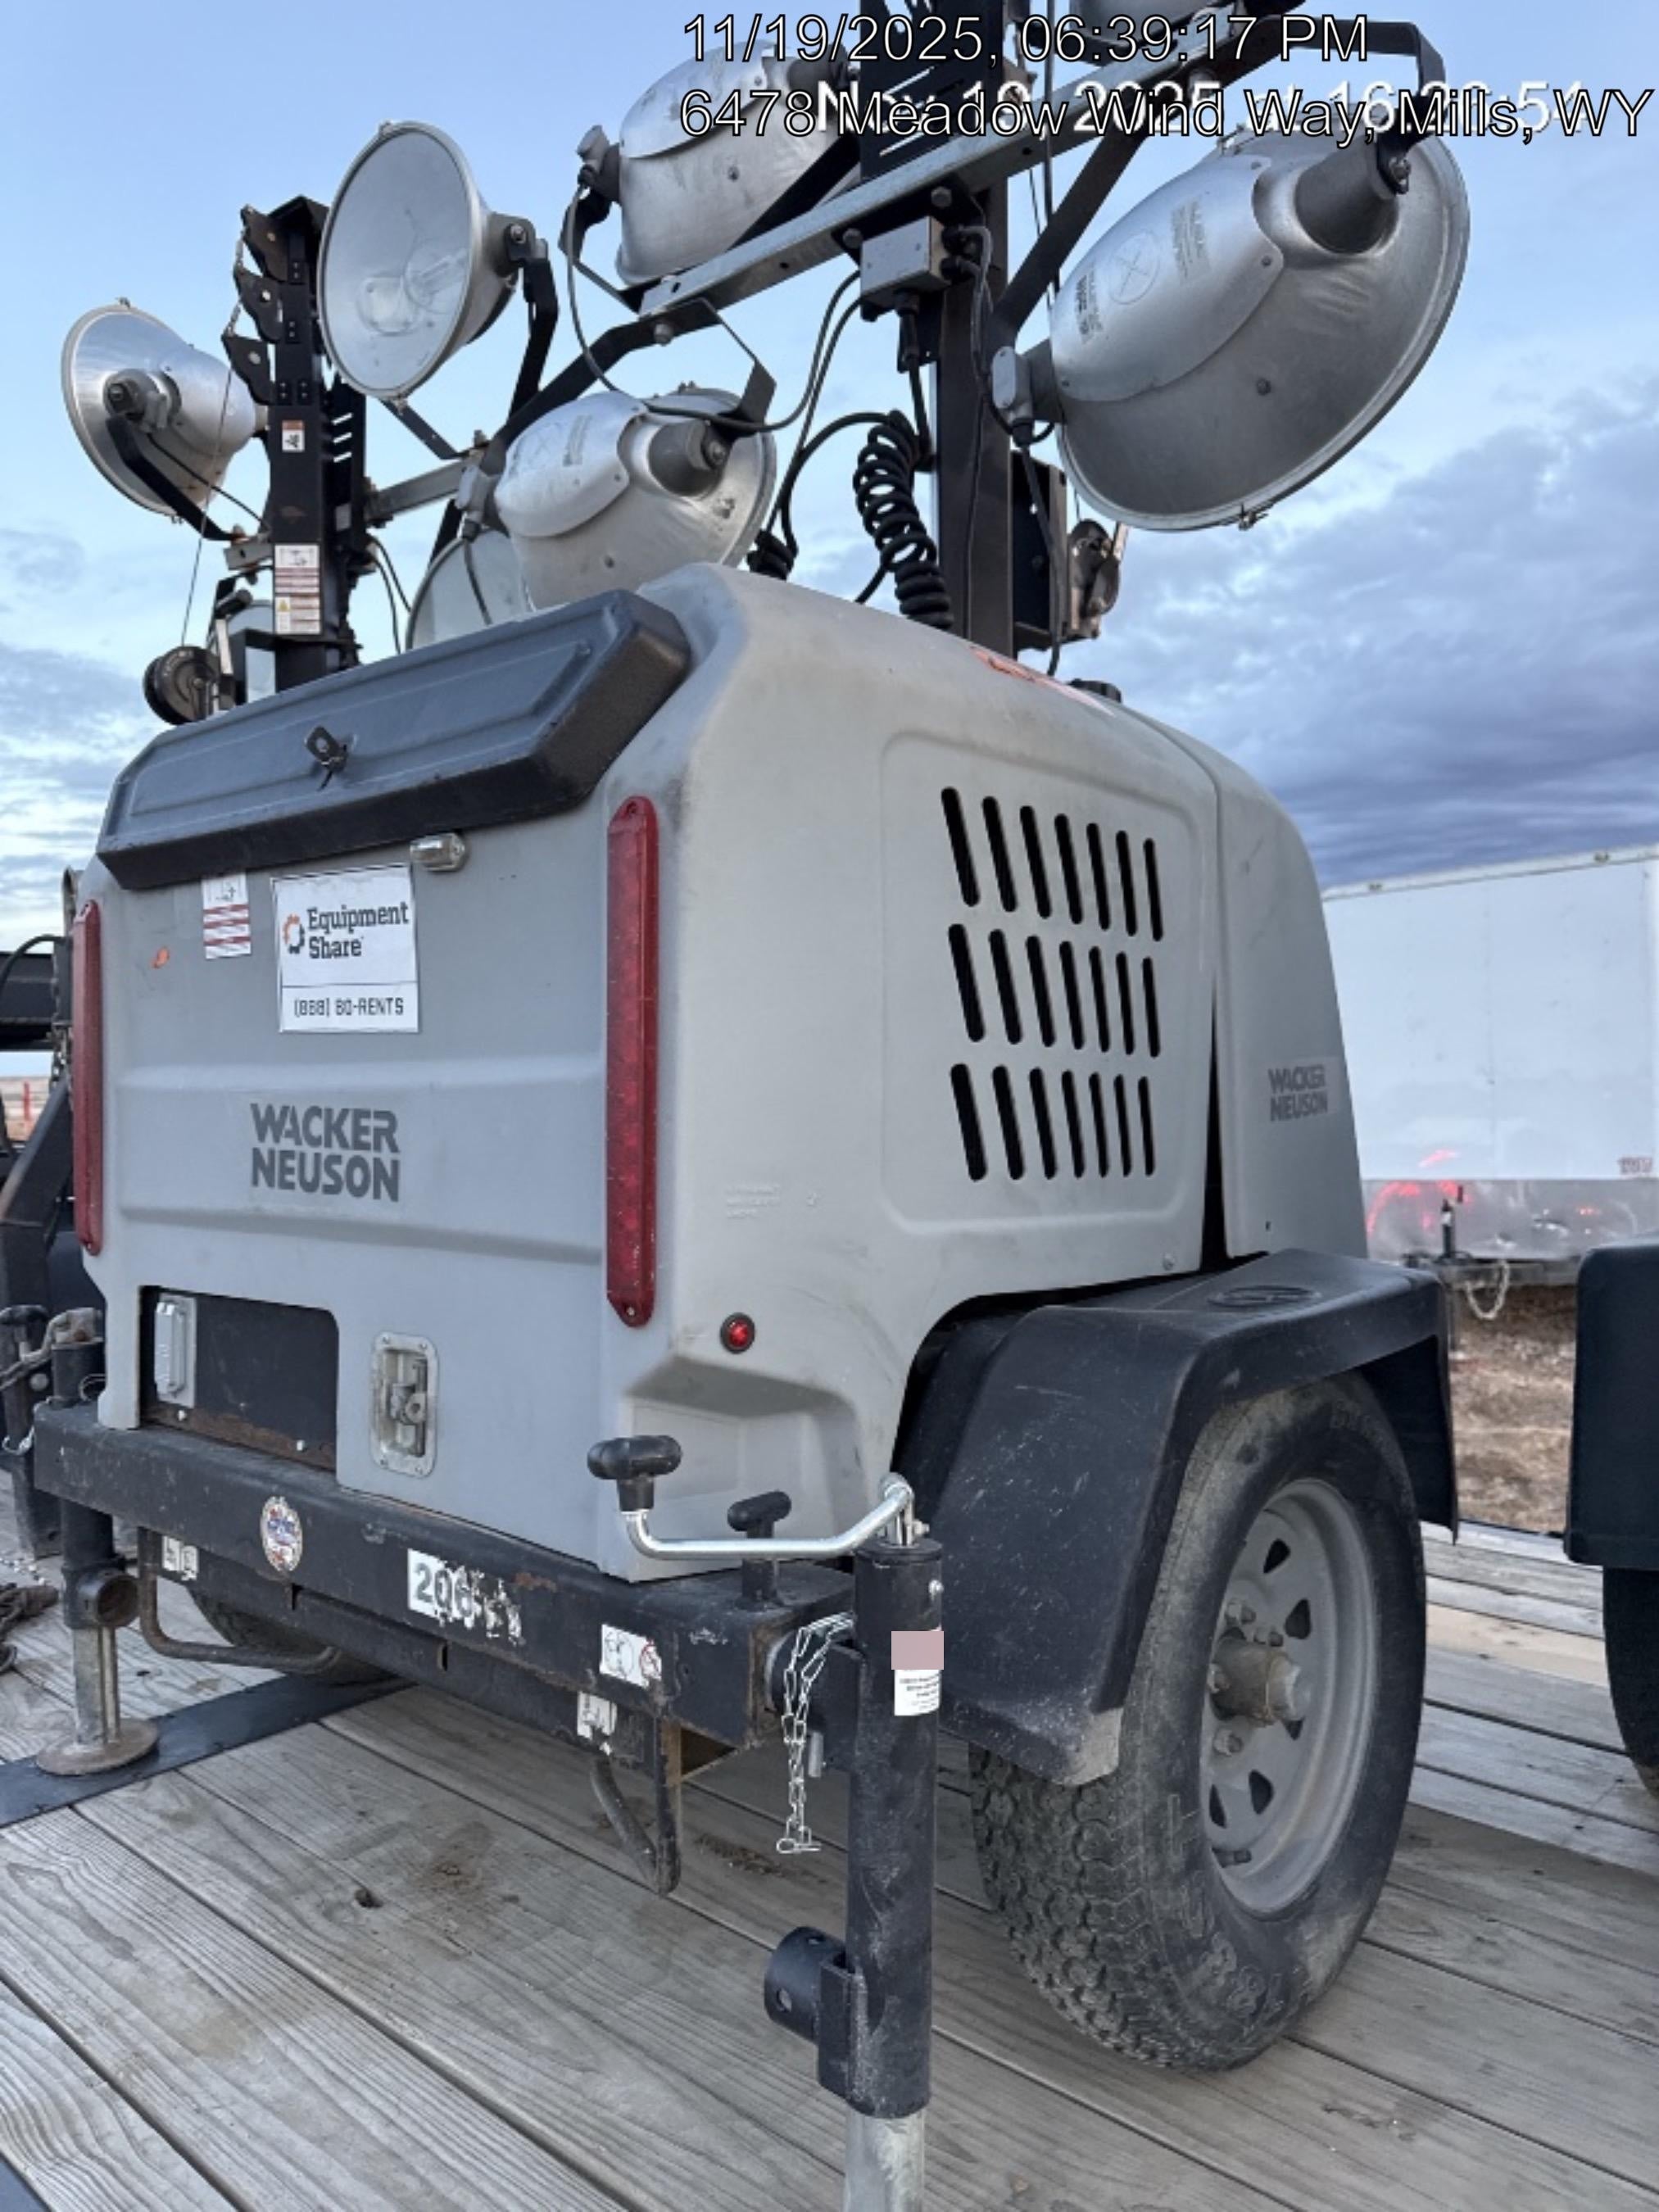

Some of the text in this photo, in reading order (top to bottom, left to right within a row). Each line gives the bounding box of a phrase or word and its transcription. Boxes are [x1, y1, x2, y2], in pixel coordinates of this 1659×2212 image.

[306, 901, 409, 935] Equipment
[308, 936, 362, 959] Share
[1267, 1064, 1326, 1094] WACKER
[1270, 1091, 1328, 1122] NEUSON
[250, 1103, 401, 1154] WACKER
[252, 1147, 400, 1203] NEUSON
